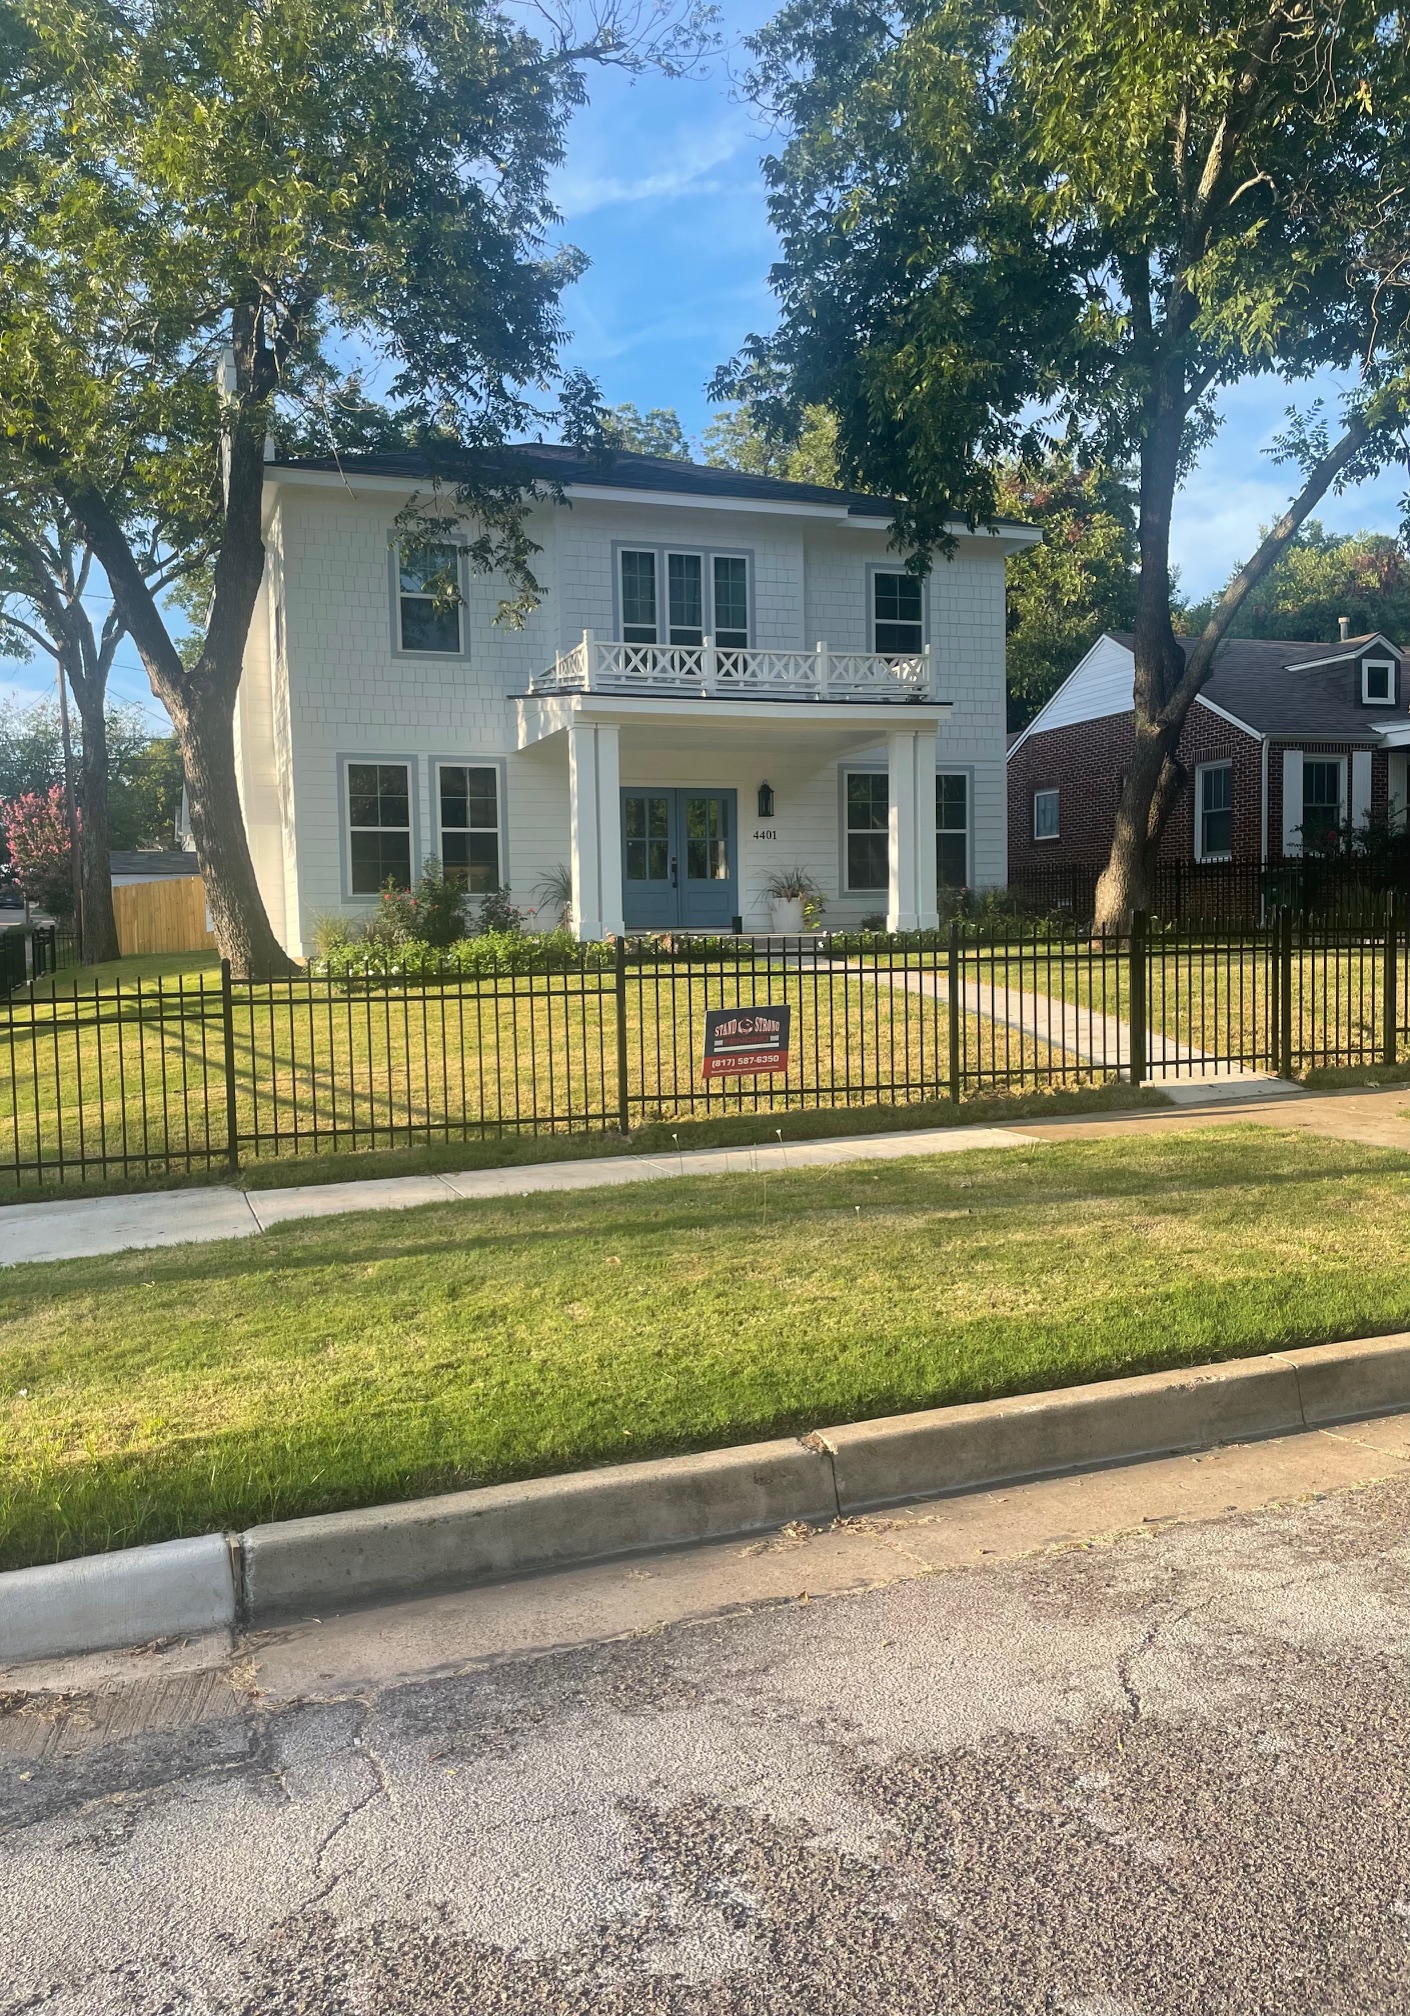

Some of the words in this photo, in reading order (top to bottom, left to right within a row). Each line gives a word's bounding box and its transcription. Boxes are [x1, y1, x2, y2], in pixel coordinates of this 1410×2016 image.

[753, 830, 777, 840] 4401
[714, 1018, 738, 1036] STAND
[754, 1016, 780, 1032] STRONG
[711, 1058, 736, 1068] (817)
[738, 1055, 779, 1065] 587-6350
